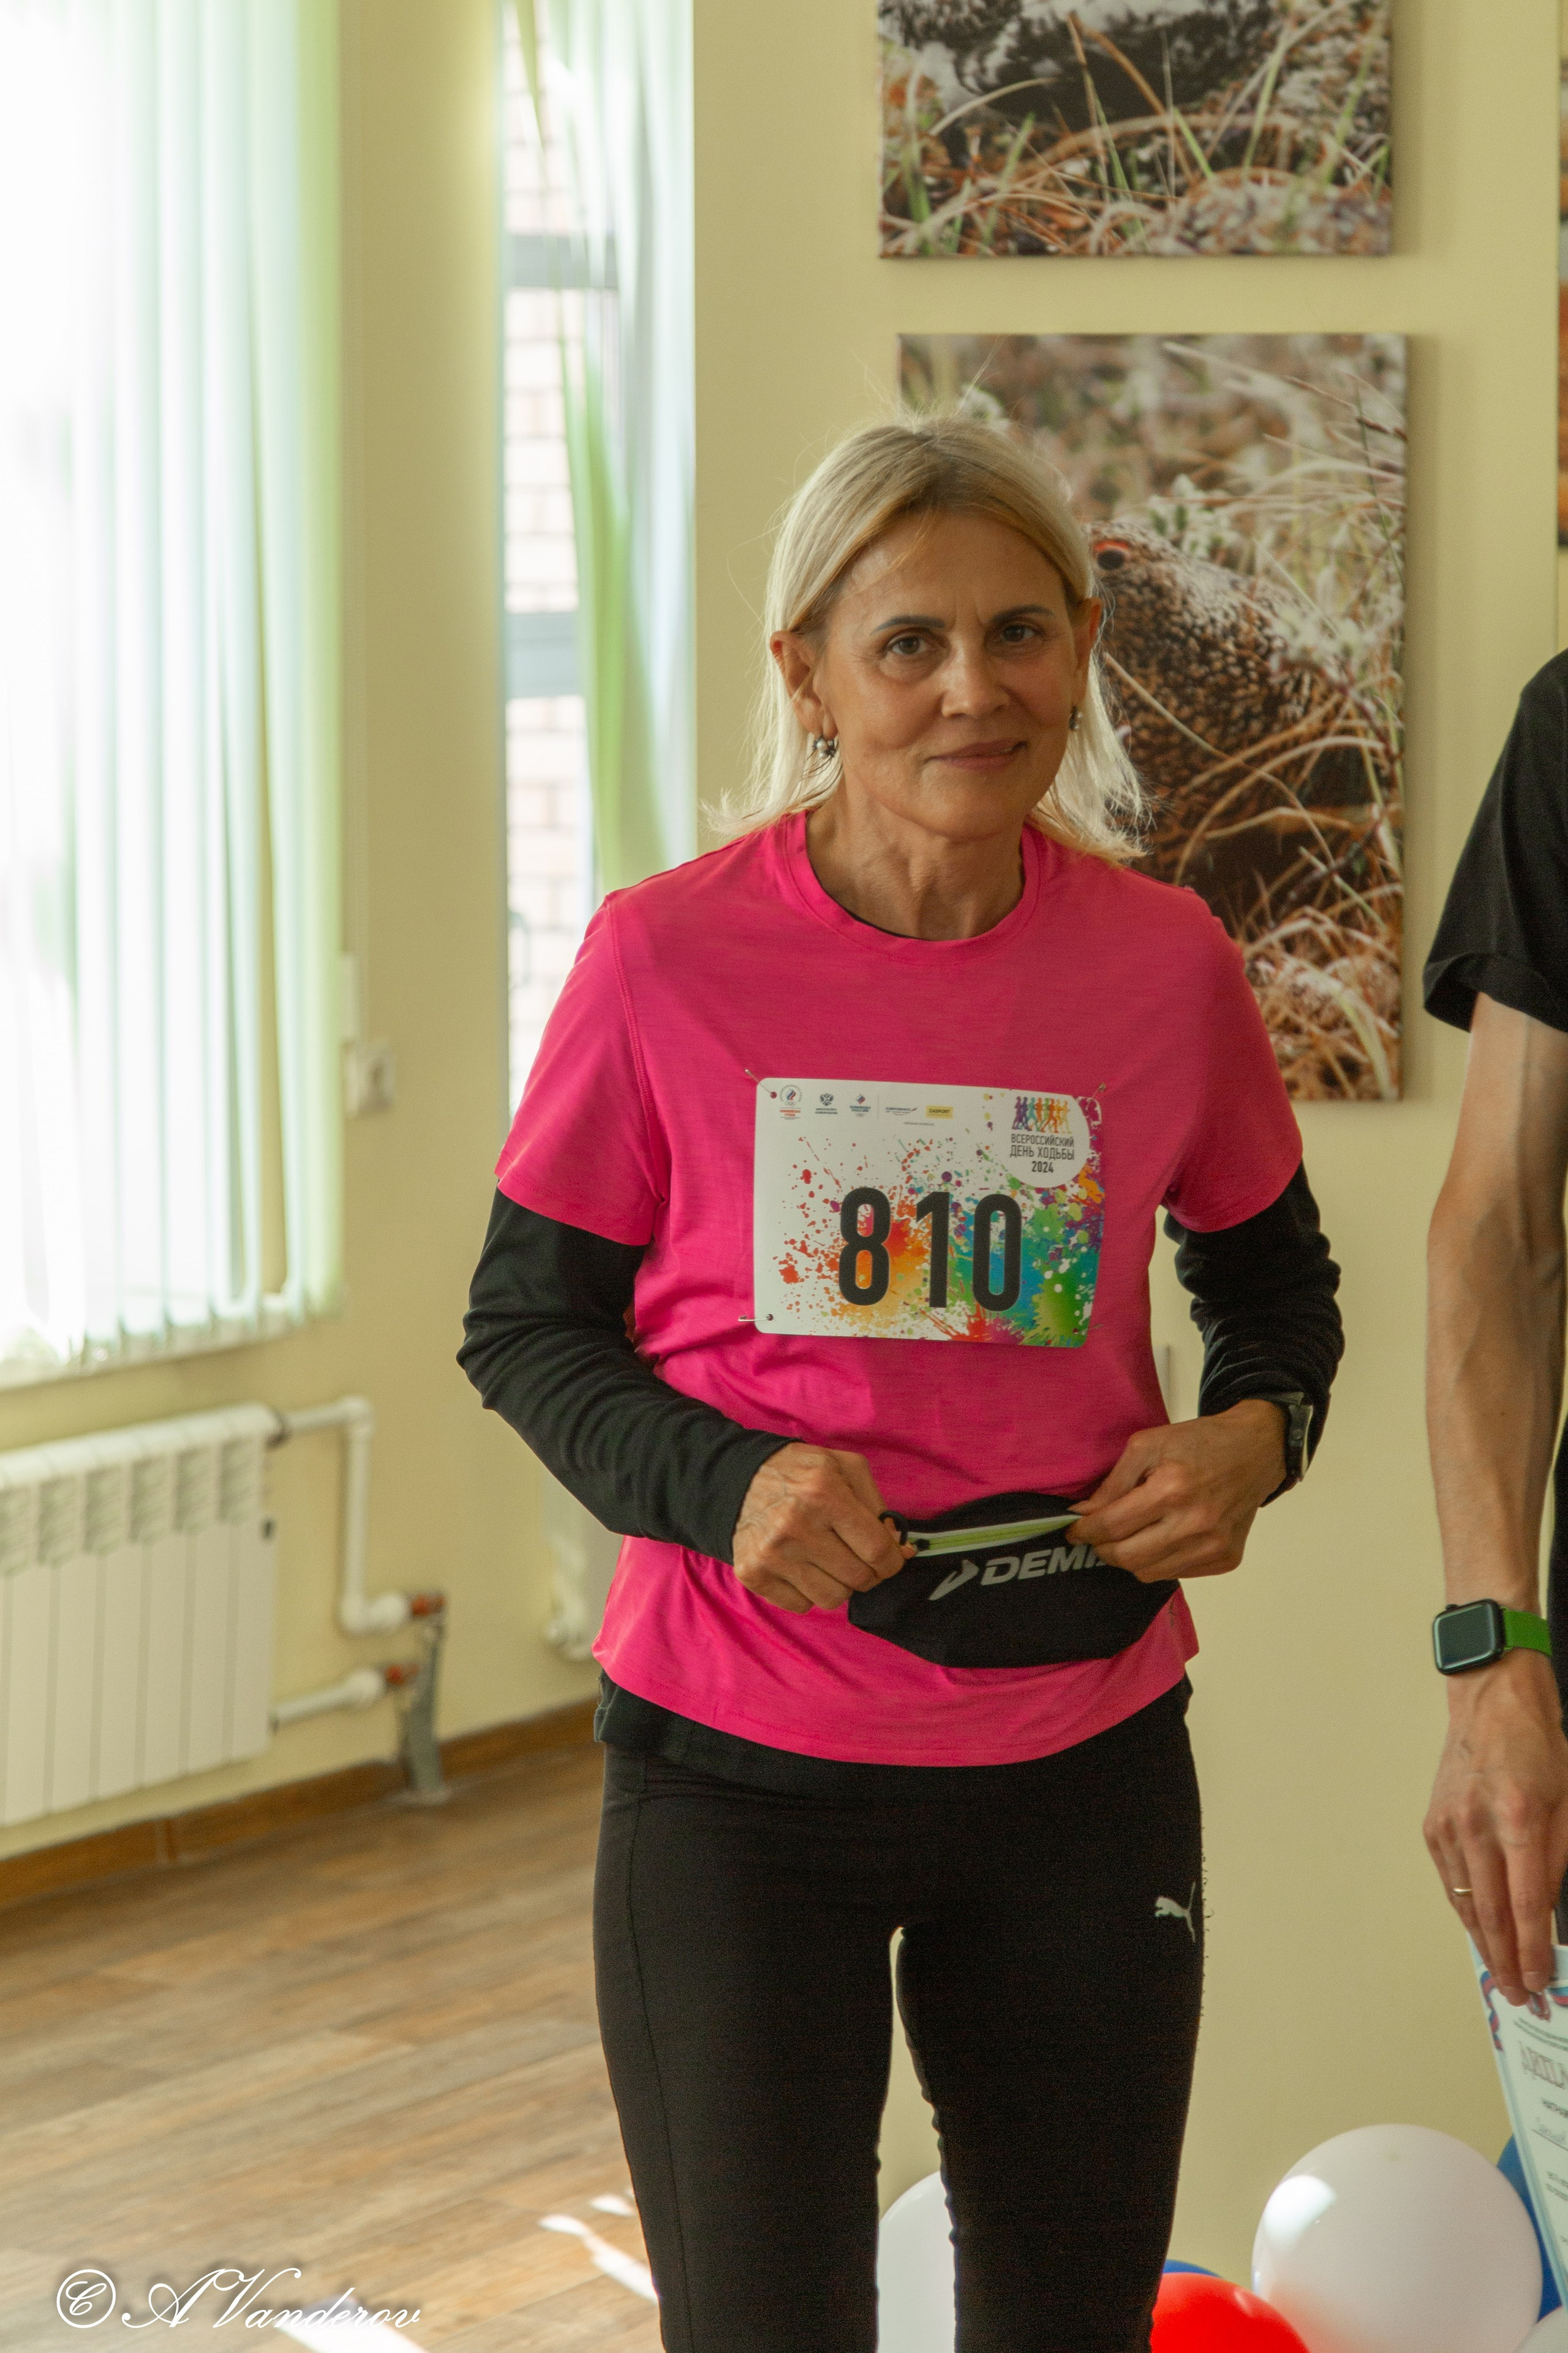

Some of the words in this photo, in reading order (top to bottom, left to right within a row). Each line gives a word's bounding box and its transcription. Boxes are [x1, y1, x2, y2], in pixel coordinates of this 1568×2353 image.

[1011, 1133, 1074, 1147] ВСЕРОССИЙСКИЙ
[1010, 1144, 1035, 1157] ДЕНЬ
[1037, 1146, 1074, 1160] ХОДЬБЫ
[1031, 1160, 1054, 1173] 2024
[839, 1187, 1022, 1312] 810
[981, 1544, 1106, 1585] DEMI
